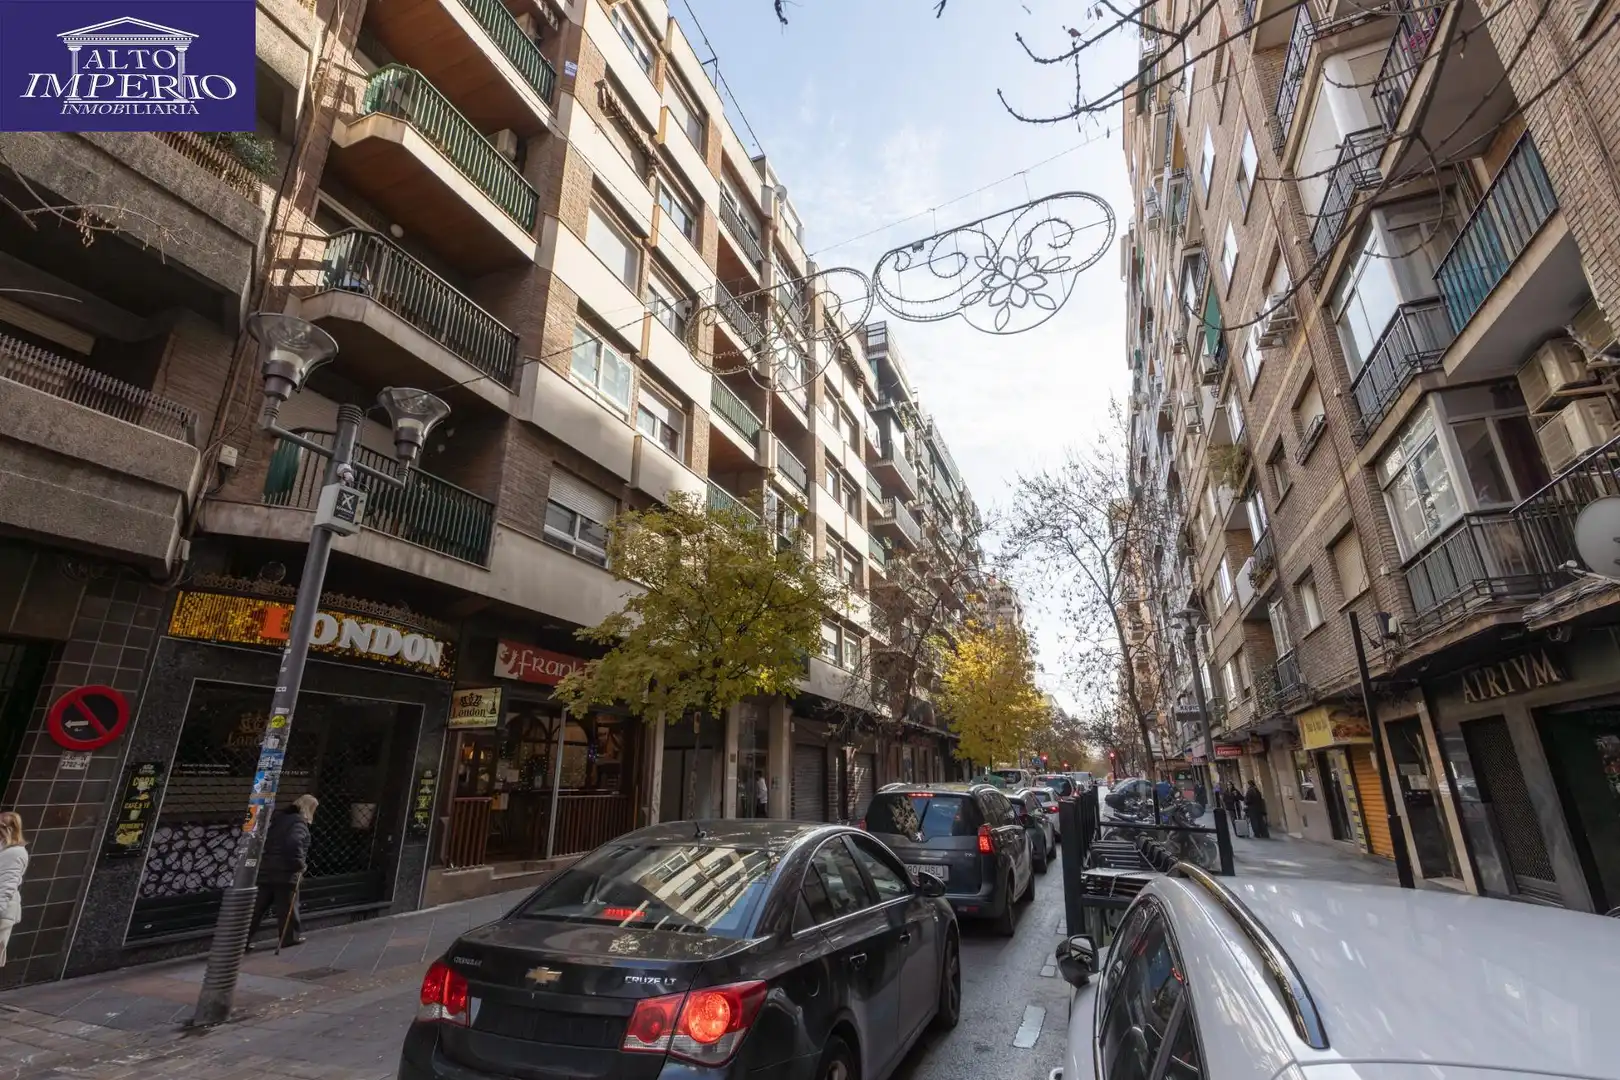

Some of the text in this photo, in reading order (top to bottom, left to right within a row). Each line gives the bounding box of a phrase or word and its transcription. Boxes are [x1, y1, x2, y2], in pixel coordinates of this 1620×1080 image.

[260, 606, 444, 668] LONDON
[625, 976, 677, 986] CRUZE LT
